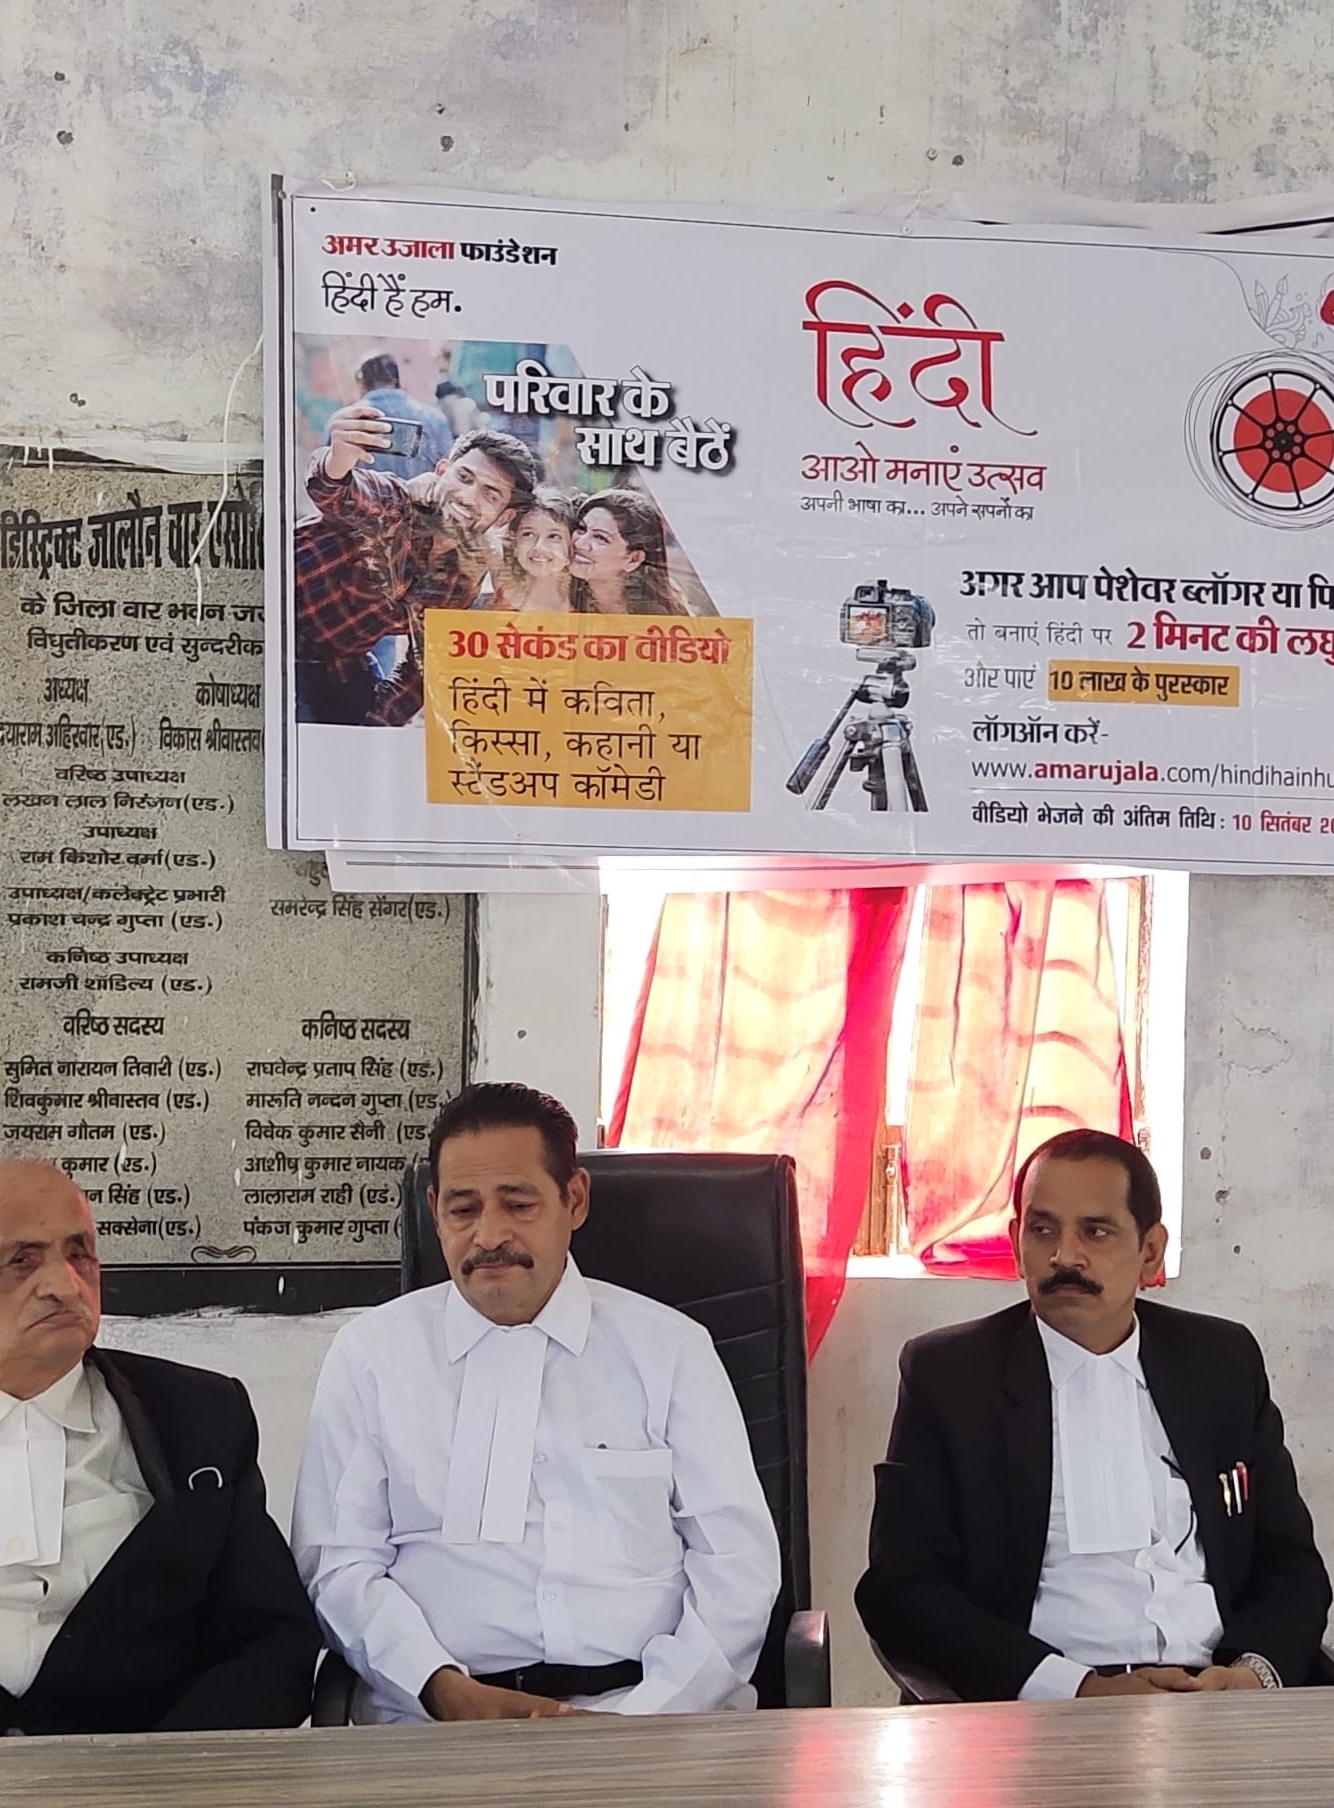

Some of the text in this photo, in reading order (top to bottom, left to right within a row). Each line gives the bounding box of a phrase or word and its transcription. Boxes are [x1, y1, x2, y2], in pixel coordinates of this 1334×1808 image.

[322, 234, 558, 266] अमर उजाला फाउंडेशन
[322, 270, 378, 314] हिंदी
[377, 273, 406, 317] हैं
[803, 279, 1038, 436] हिंदी
[483, 358, 670, 419] परिवार के
[576, 418, 732, 470] साथ बैठें
[801, 441, 1048, 495] आओ मनाएं उत्सव
[800, 490, 843, 512] अपनी
[848, 498, 881, 514] भाषा
[931, 496, 968, 518] अपने
[1014, 505, 1034, 521] का
[88, 488, 163, 569] जालौन
[20, 591, 116, 618] के जिला
[960, 570, 1025, 597] अगर
[1029, 573, 1088, 600] आप
[1094, 567, 1176, 606] पेशेवर
[1180, 572, 1265, 608] ब्लॉगर
[1271, 581, 1300, 609] या
[145, 631, 176, 652] एवं
[448, 621, 731, 664] 30 सेकंड का वीडियो
[966, 618, 985, 641] तो
[993, 621, 1040, 646] बनाएं
[1046, 621, 1083, 646] हिंदी
[1091, 628, 1113, 646] पर
[1127, 622, 1146, 649] 2
[1154, 609, 1230, 653] मिनट
[1236, 615, 1279, 655] की
[43, 677, 89, 703] अध्यक्ष
[195, 672, 261, 709] कोषाध्यक्ष
[964, 661, 1229, 700] और पाएं 10 लाख के पुरस्कार
[448, 676, 666, 723] हिंदी में कविता,
[563, 724, 656, 761] कहानी
[668, 733, 701, 760] या
[972, 714, 1059, 744] लॉगऑन
[112, 770, 185, 784] उपाध्यक्ष
[571, 764, 666, 801] कॉमेडी
[971, 803, 1029, 825] वीडियो
[1037, 803, 1084, 827] भेजने
[1093, 805, 1114, 827] की
[1123, 804, 1170, 829] अंतिम
[1232, 814, 1253, 832] 10
[1260, 810, 1312, 834] सितंबर
[7, 913, 66, 928] प्रकाश
[72, 913, 111, 928] चन्द्र
[117, 913, 165, 933] गुप्ता
[63, 1008, 165, 1036] वरिष्ठ सदस्य
[301, 1010, 411, 1041] कनिष्ठ सदस्य
[4, 1056, 53, 1084] सुमित
[123, 1056, 172, 1078] तिवारी
[246, 1057, 308, 1079] राघवेन्द्र
[314, 1062, 356, 1079] प्रताप
[361, 1056, 394, 1077] सिंह
